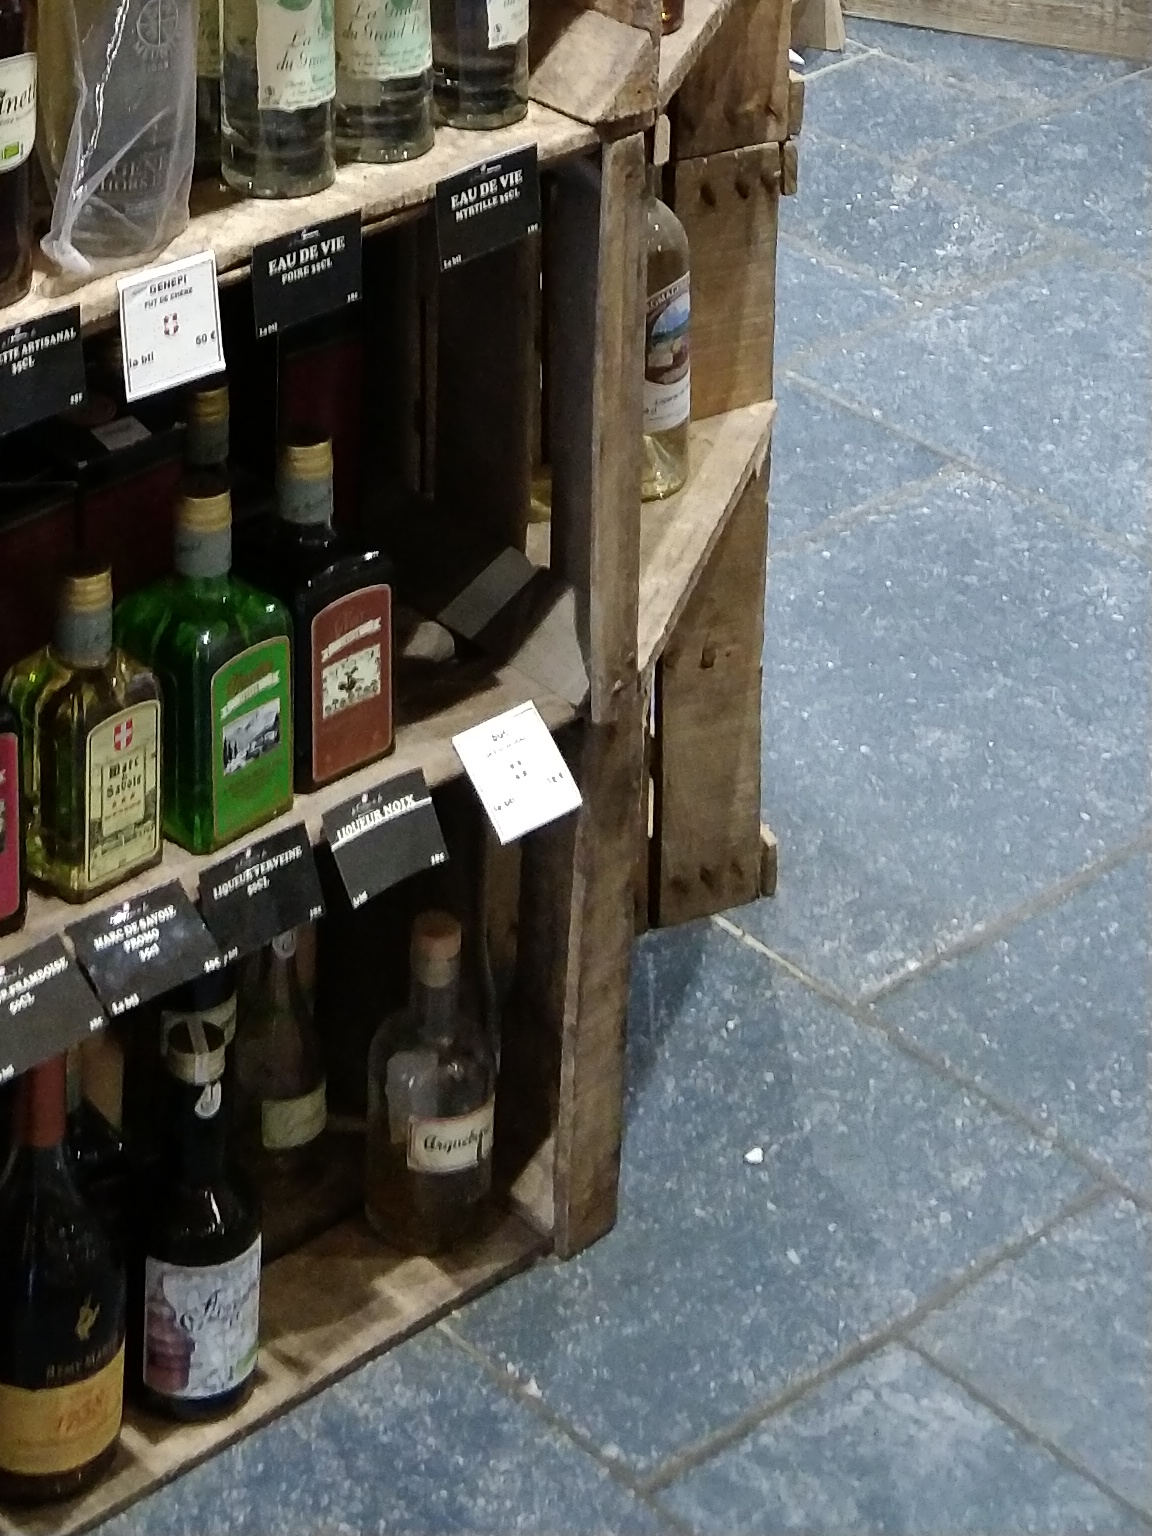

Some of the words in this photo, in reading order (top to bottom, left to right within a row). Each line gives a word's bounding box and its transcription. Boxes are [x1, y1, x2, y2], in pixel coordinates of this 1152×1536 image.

[450, 185, 478, 210] EAU
[479, 178, 499, 199] DE
[499, 168, 524, 190] VIE
[455, 195, 499, 223] MYRTILLE
[268, 251, 297, 277] EAU
[299, 244, 319, 265] DE
[320, 235, 346, 256] VIE
[281, 264, 310, 285] POIRE
[149, 274, 188, 295] GENEPI
[21, 326, 77, 357] ARTISANAL
[335, 808, 383, 841] LIQUEUR
[383, 793, 417, 819] NOIX
[212, 867, 253, 901] LIQUEUR
[252, 844, 304, 878] VERVEINE
[93, 927, 124, 952] MARC
[123, 921, 140, 939] DE
[139, 904, 177, 932] SAVOIE
[8, 955, 69, 997] FRAMBOISE
